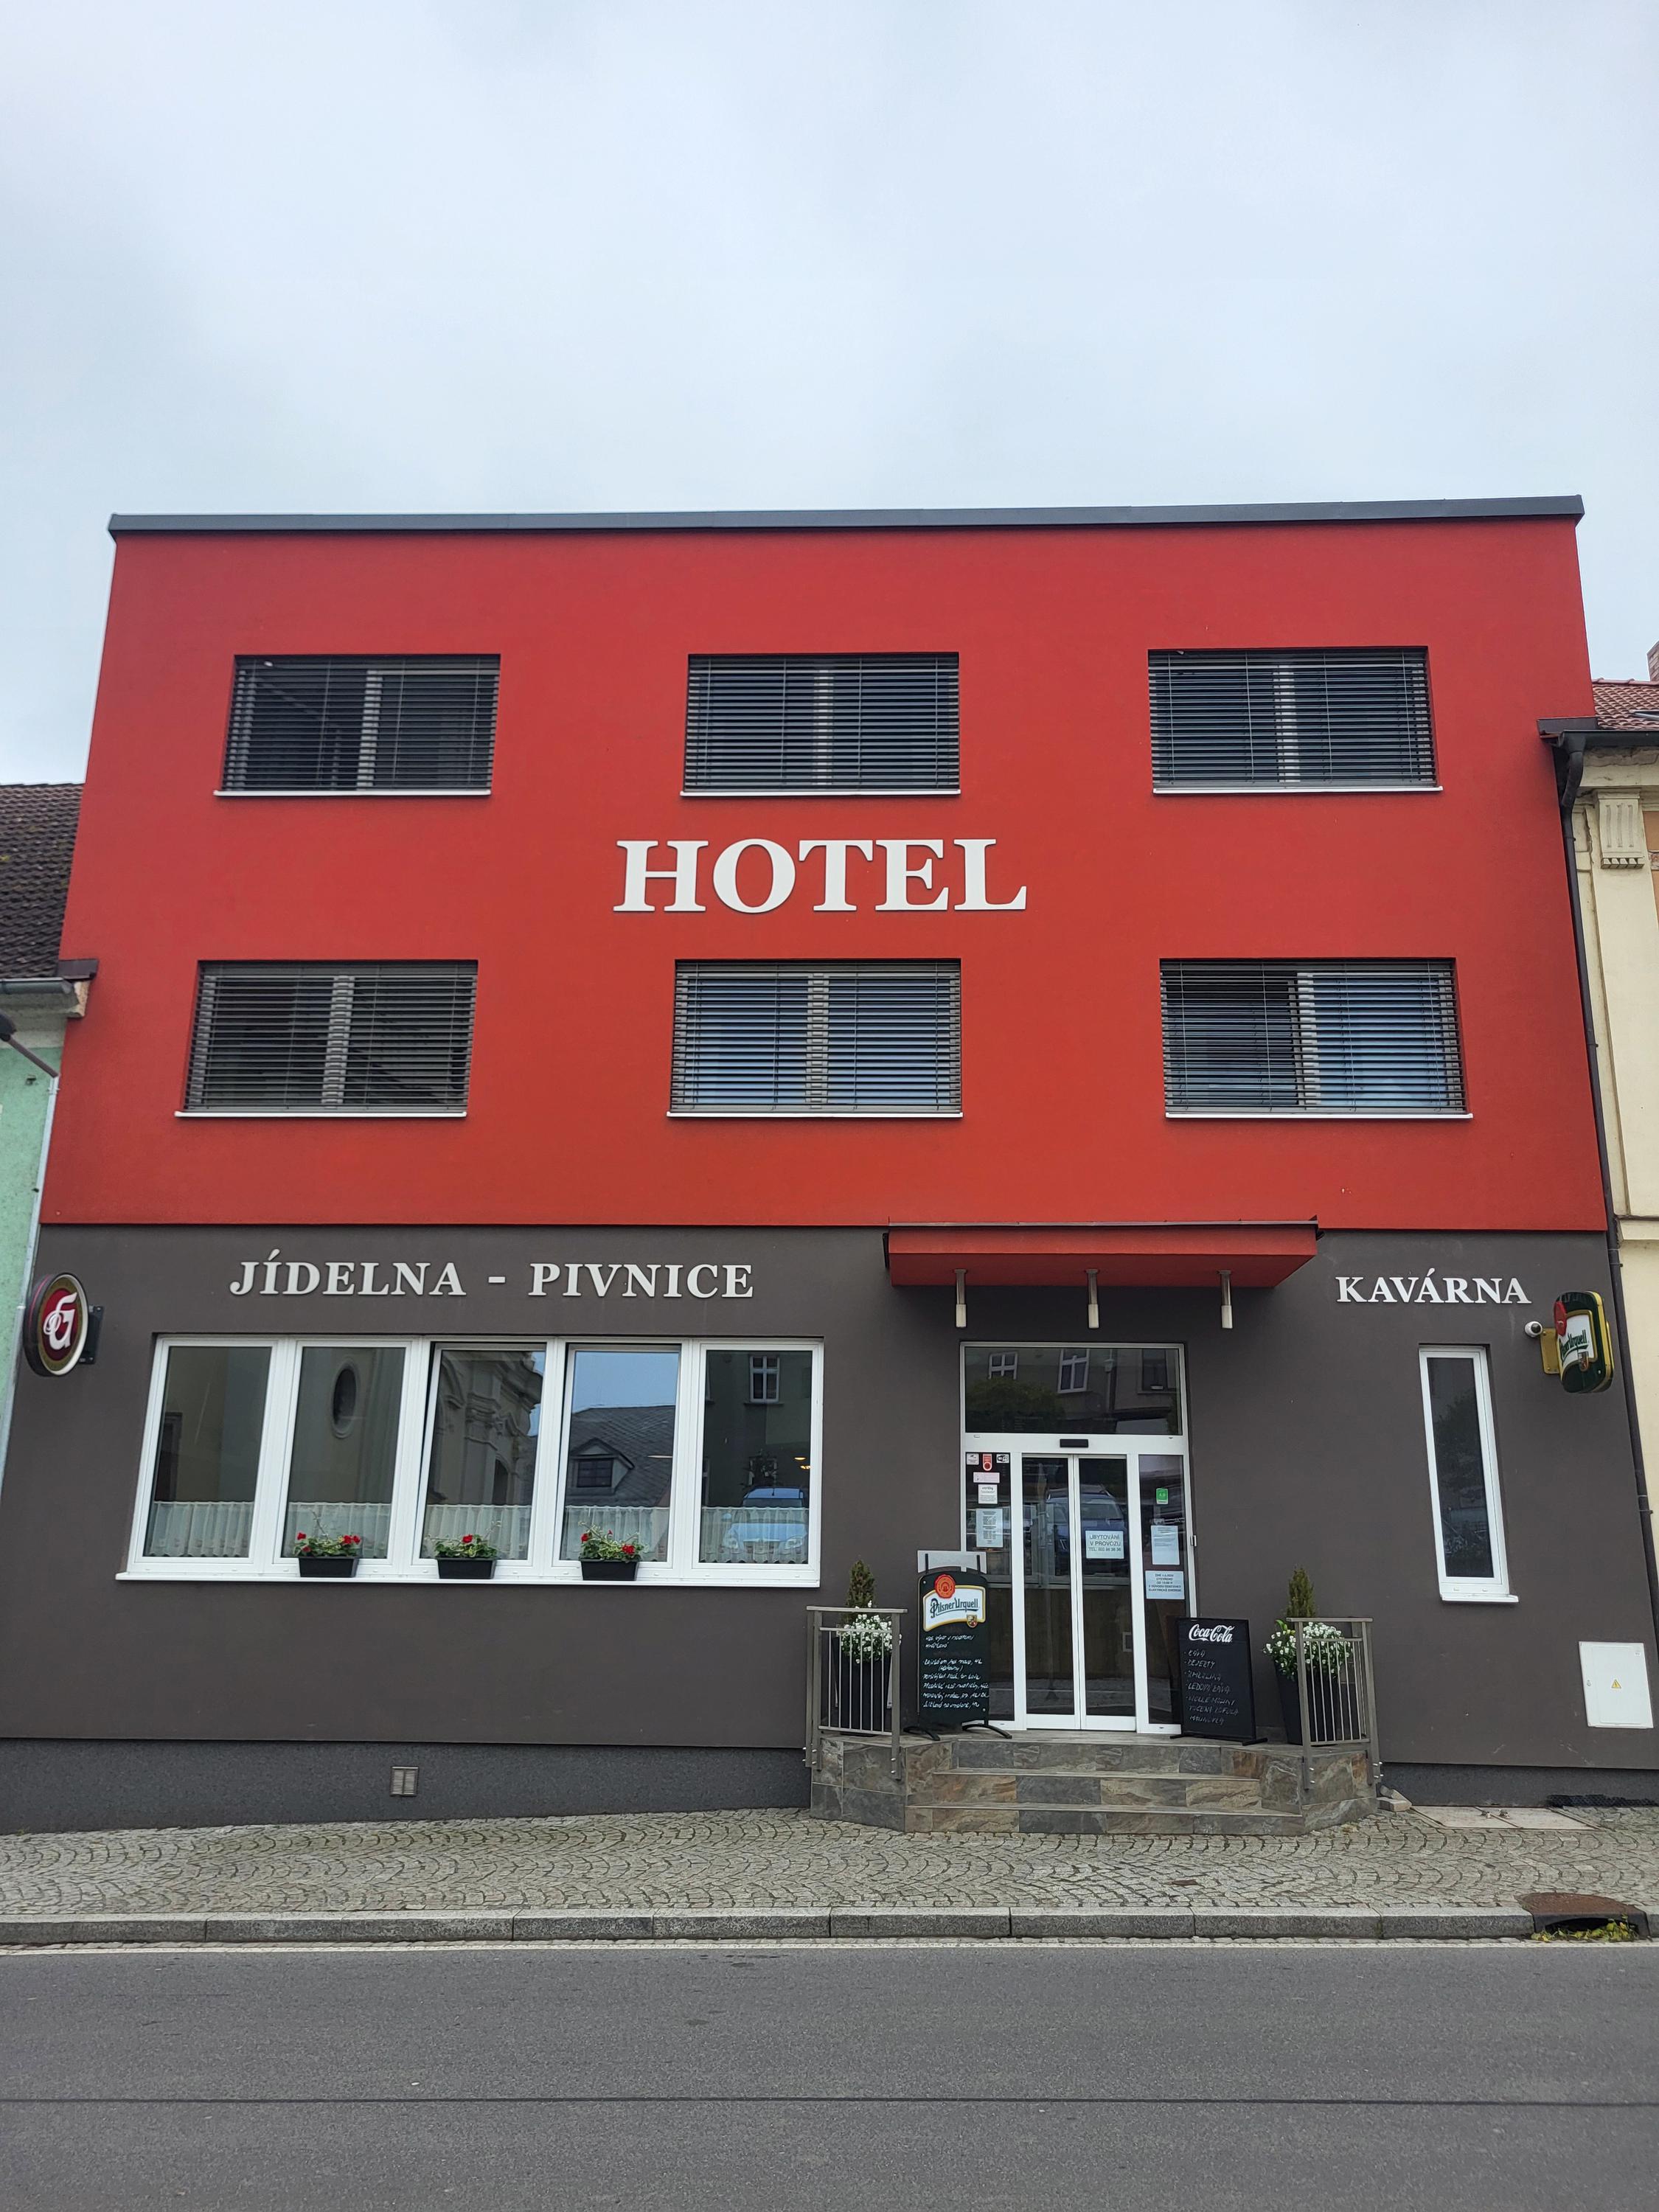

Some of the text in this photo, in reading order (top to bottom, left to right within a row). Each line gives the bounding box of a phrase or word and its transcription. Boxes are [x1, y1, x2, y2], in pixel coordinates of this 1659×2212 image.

[613, 838, 1027, 914] HOTEL
[229, 1248, 754, 1298] JÍDELNA - PIVNICE
[1335, 1267, 1532, 1304] KAVÁRNA
[930, 1597, 978, 1618] Pilsner Urquell
[1189, 1624, 1235, 1643] Coca-Cola
